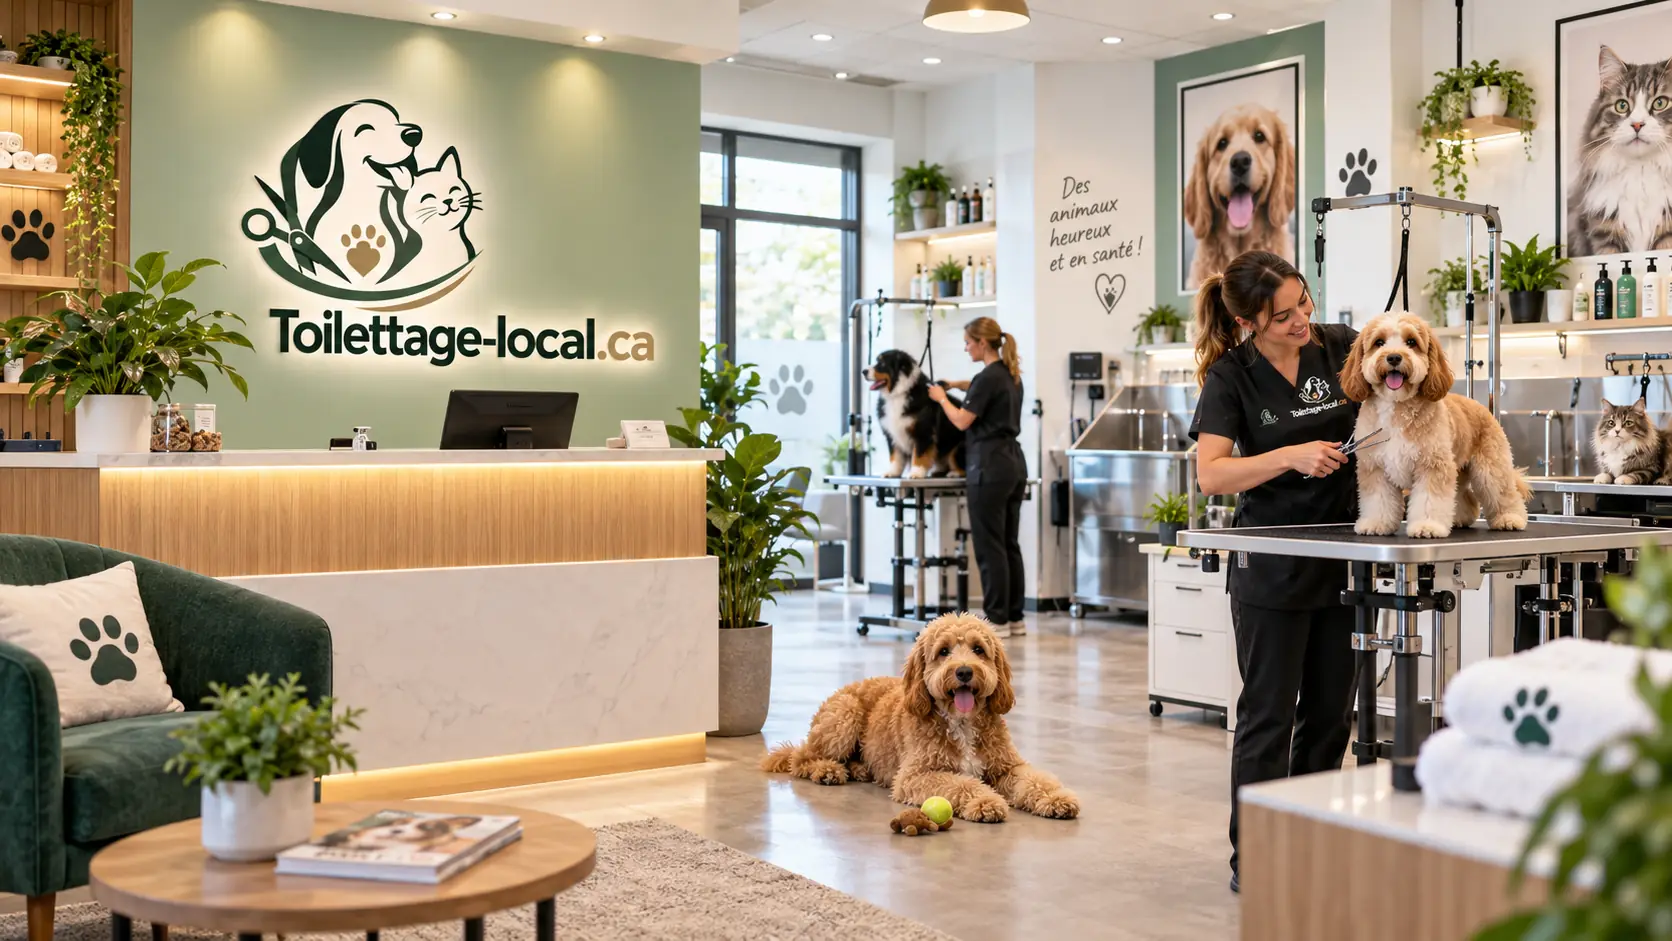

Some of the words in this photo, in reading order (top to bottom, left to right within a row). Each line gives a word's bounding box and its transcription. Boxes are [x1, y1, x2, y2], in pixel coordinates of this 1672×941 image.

[1062, 176, 1091, 200] Des
[1049, 199, 1118, 223] animaux
[1049, 224, 1112, 247] heureux
[1049, 253, 1064, 272] et
[1069, 255, 1087, 268] en
[269, 308, 655, 367] Toilettage-local.ca
